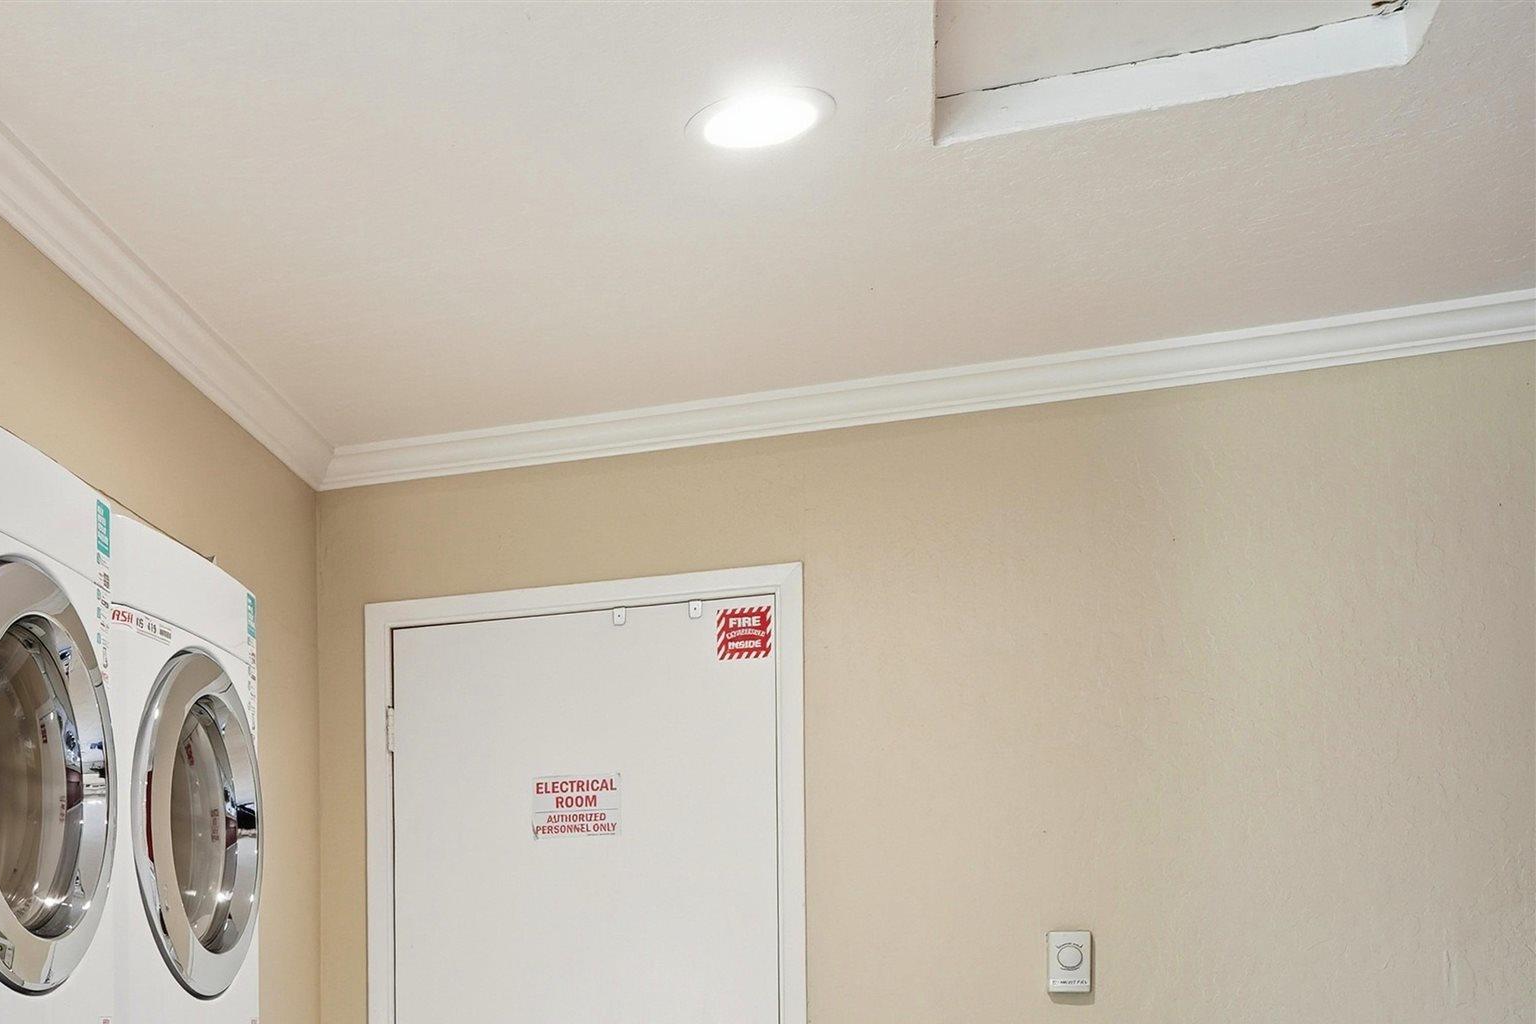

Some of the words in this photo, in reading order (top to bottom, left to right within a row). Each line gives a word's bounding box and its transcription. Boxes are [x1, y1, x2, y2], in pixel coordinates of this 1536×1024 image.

[111, 610, 133, 623] ASH
[729, 616, 761, 628] FIRE
[728, 639, 762, 649] INSIDE
[536, 778, 617, 795] ELECTRICAL
[556, 795, 597, 808] ROOM
[547, 813, 606, 824] AUTHORIZED
[536, 823, 591, 835] PERSONNEL
[592, 822, 617, 832] ONLY
